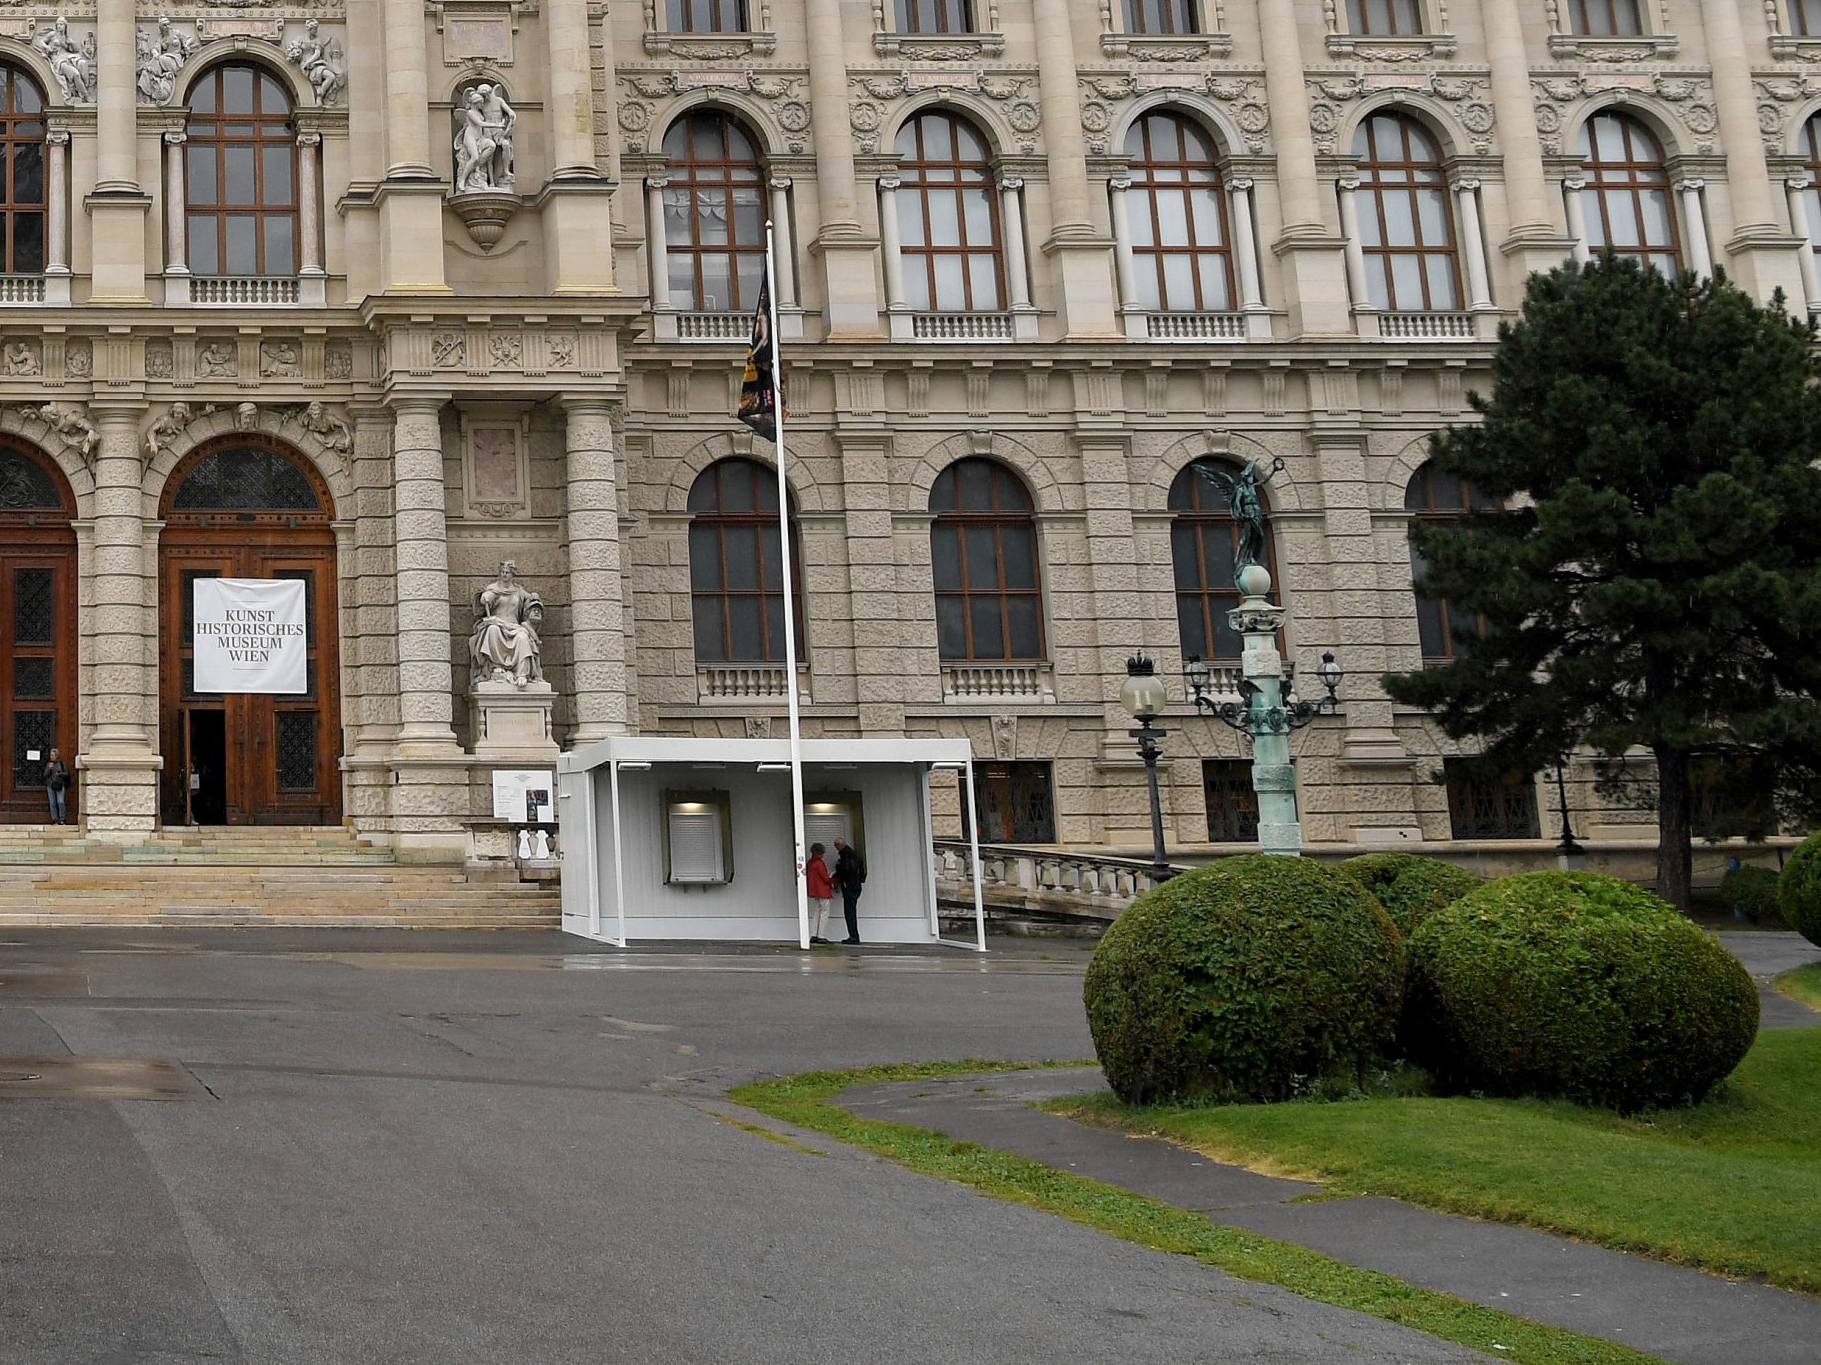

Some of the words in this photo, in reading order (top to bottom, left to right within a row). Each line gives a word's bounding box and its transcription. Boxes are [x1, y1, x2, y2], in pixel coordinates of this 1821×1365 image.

[225, 609, 275, 622] KUNST
[196, 623, 304, 636] HISTORISCHES
[217, 636, 283, 649] MUSEUM
[229, 650, 270, 662] WIEN
